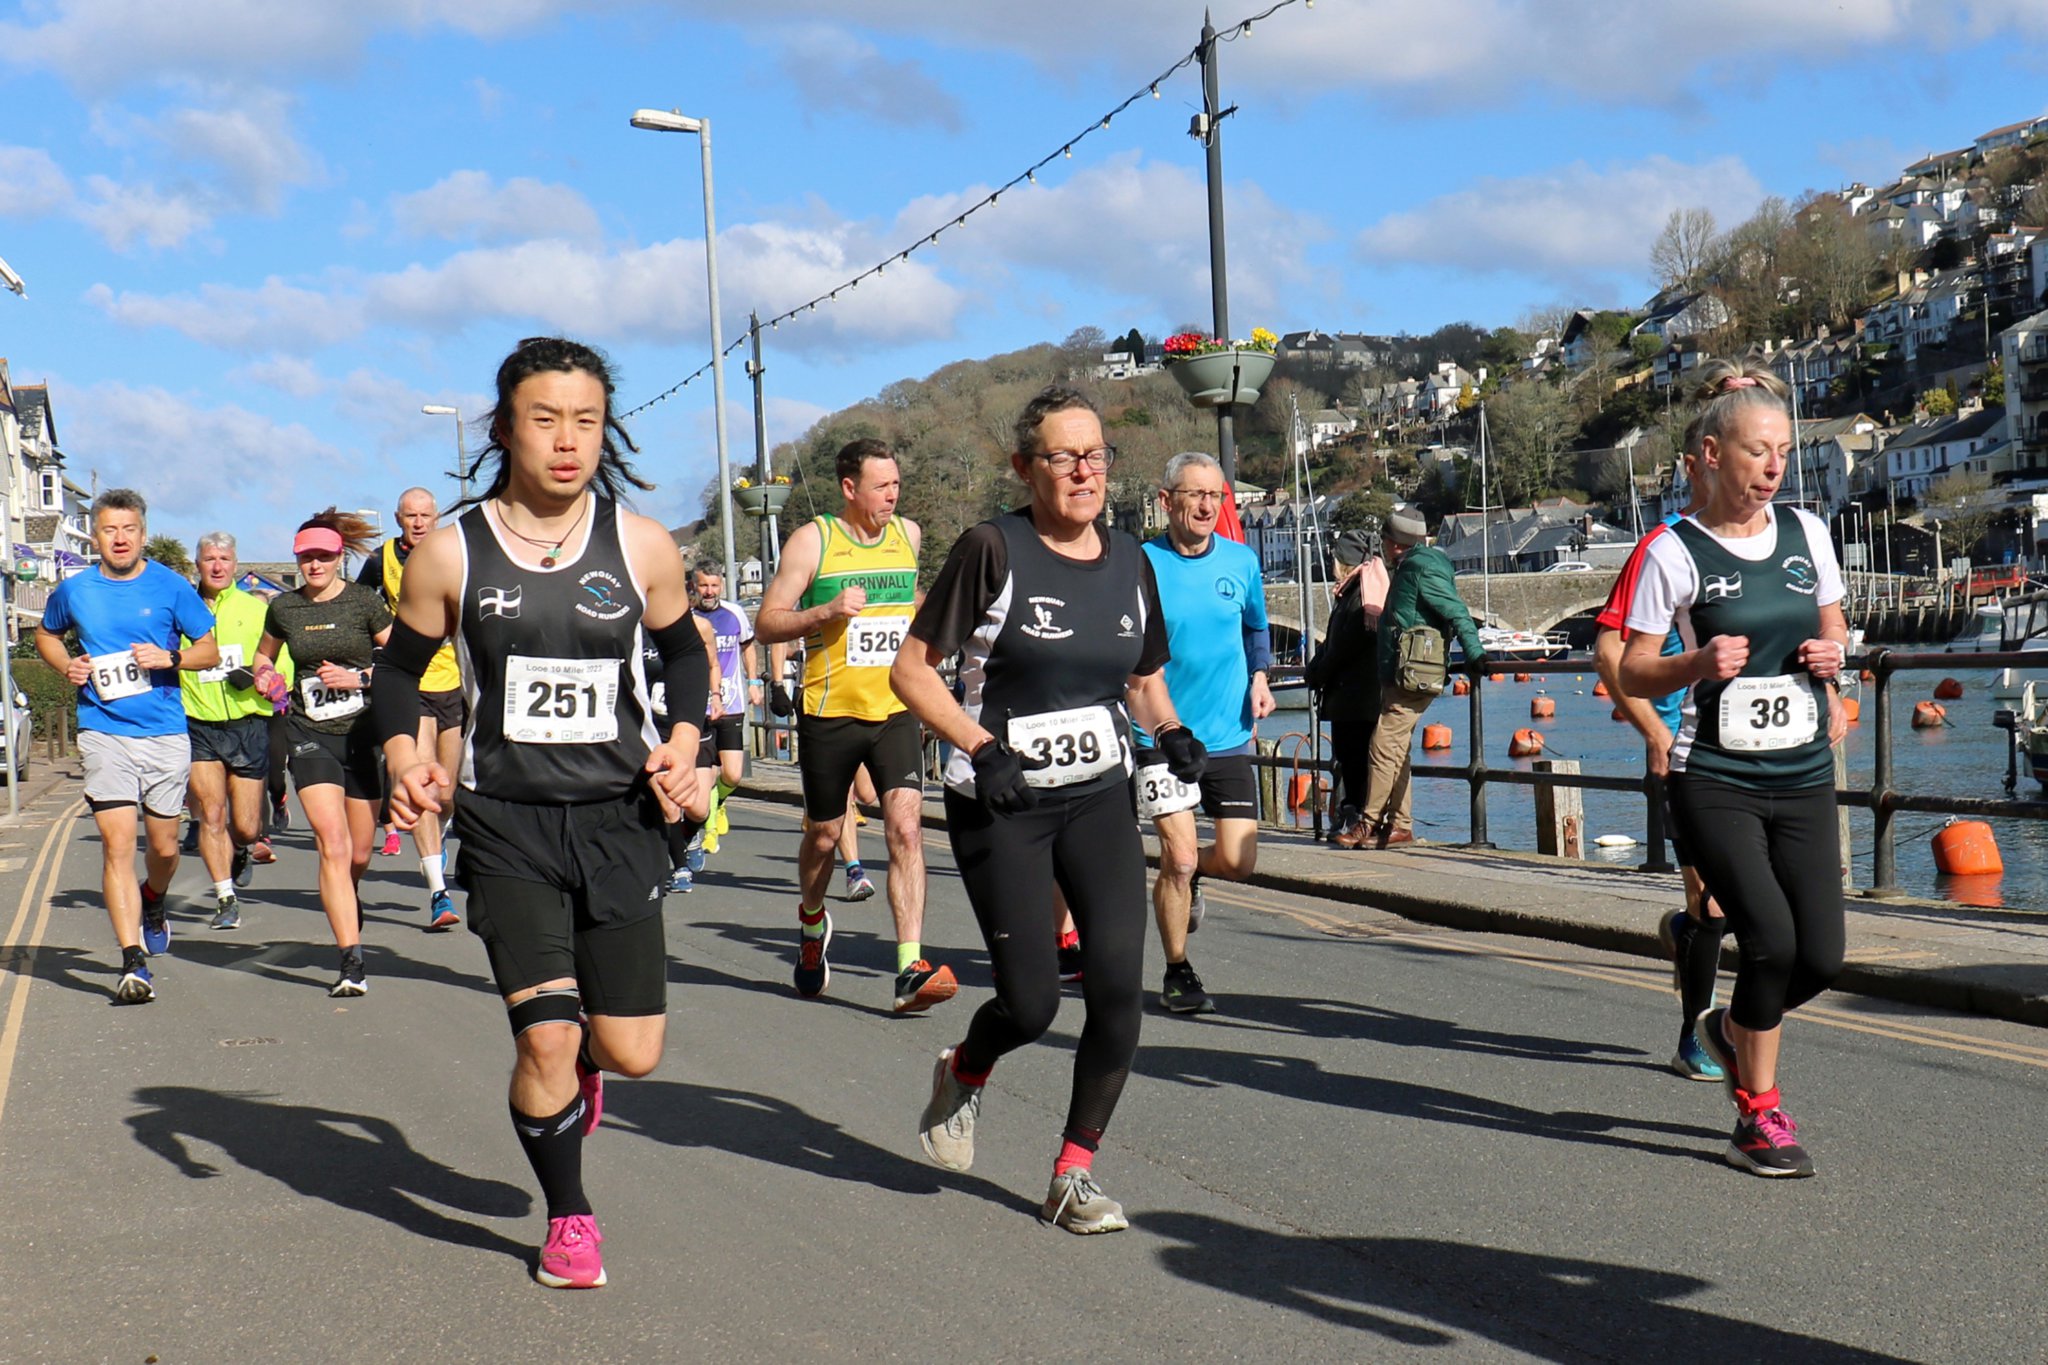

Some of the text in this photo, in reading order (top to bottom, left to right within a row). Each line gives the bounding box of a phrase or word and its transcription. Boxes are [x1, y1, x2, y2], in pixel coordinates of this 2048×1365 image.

[578, 570, 622, 588] NEWQUAY
[840, 575, 908, 590] CORNWALL
[1028, 596, 1066, 608] NEWQUAY
[575, 603, 630, 620] ROAD RUNNERS
[1020, 624, 1074, 640] ROAD RUNNERS
[860, 630, 900, 653] 526
[98, 662, 139, 688] 516
[526, 663, 548, 672] Looe
[563, 665, 585, 674] Miler
[1737, 682, 1757, 690] Looe
[312, 686, 350, 708] 245
[527, 680, 597, 719] 251
[1750, 695, 1790, 730] 38
[1026, 721, 1046, 730] Looe
[1049, 718, 1058, 727] 10
[1060, 715, 1079, 725] Miler
[1031, 730, 1101, 770] 339
[1145, 777, 1188, 802] 336
